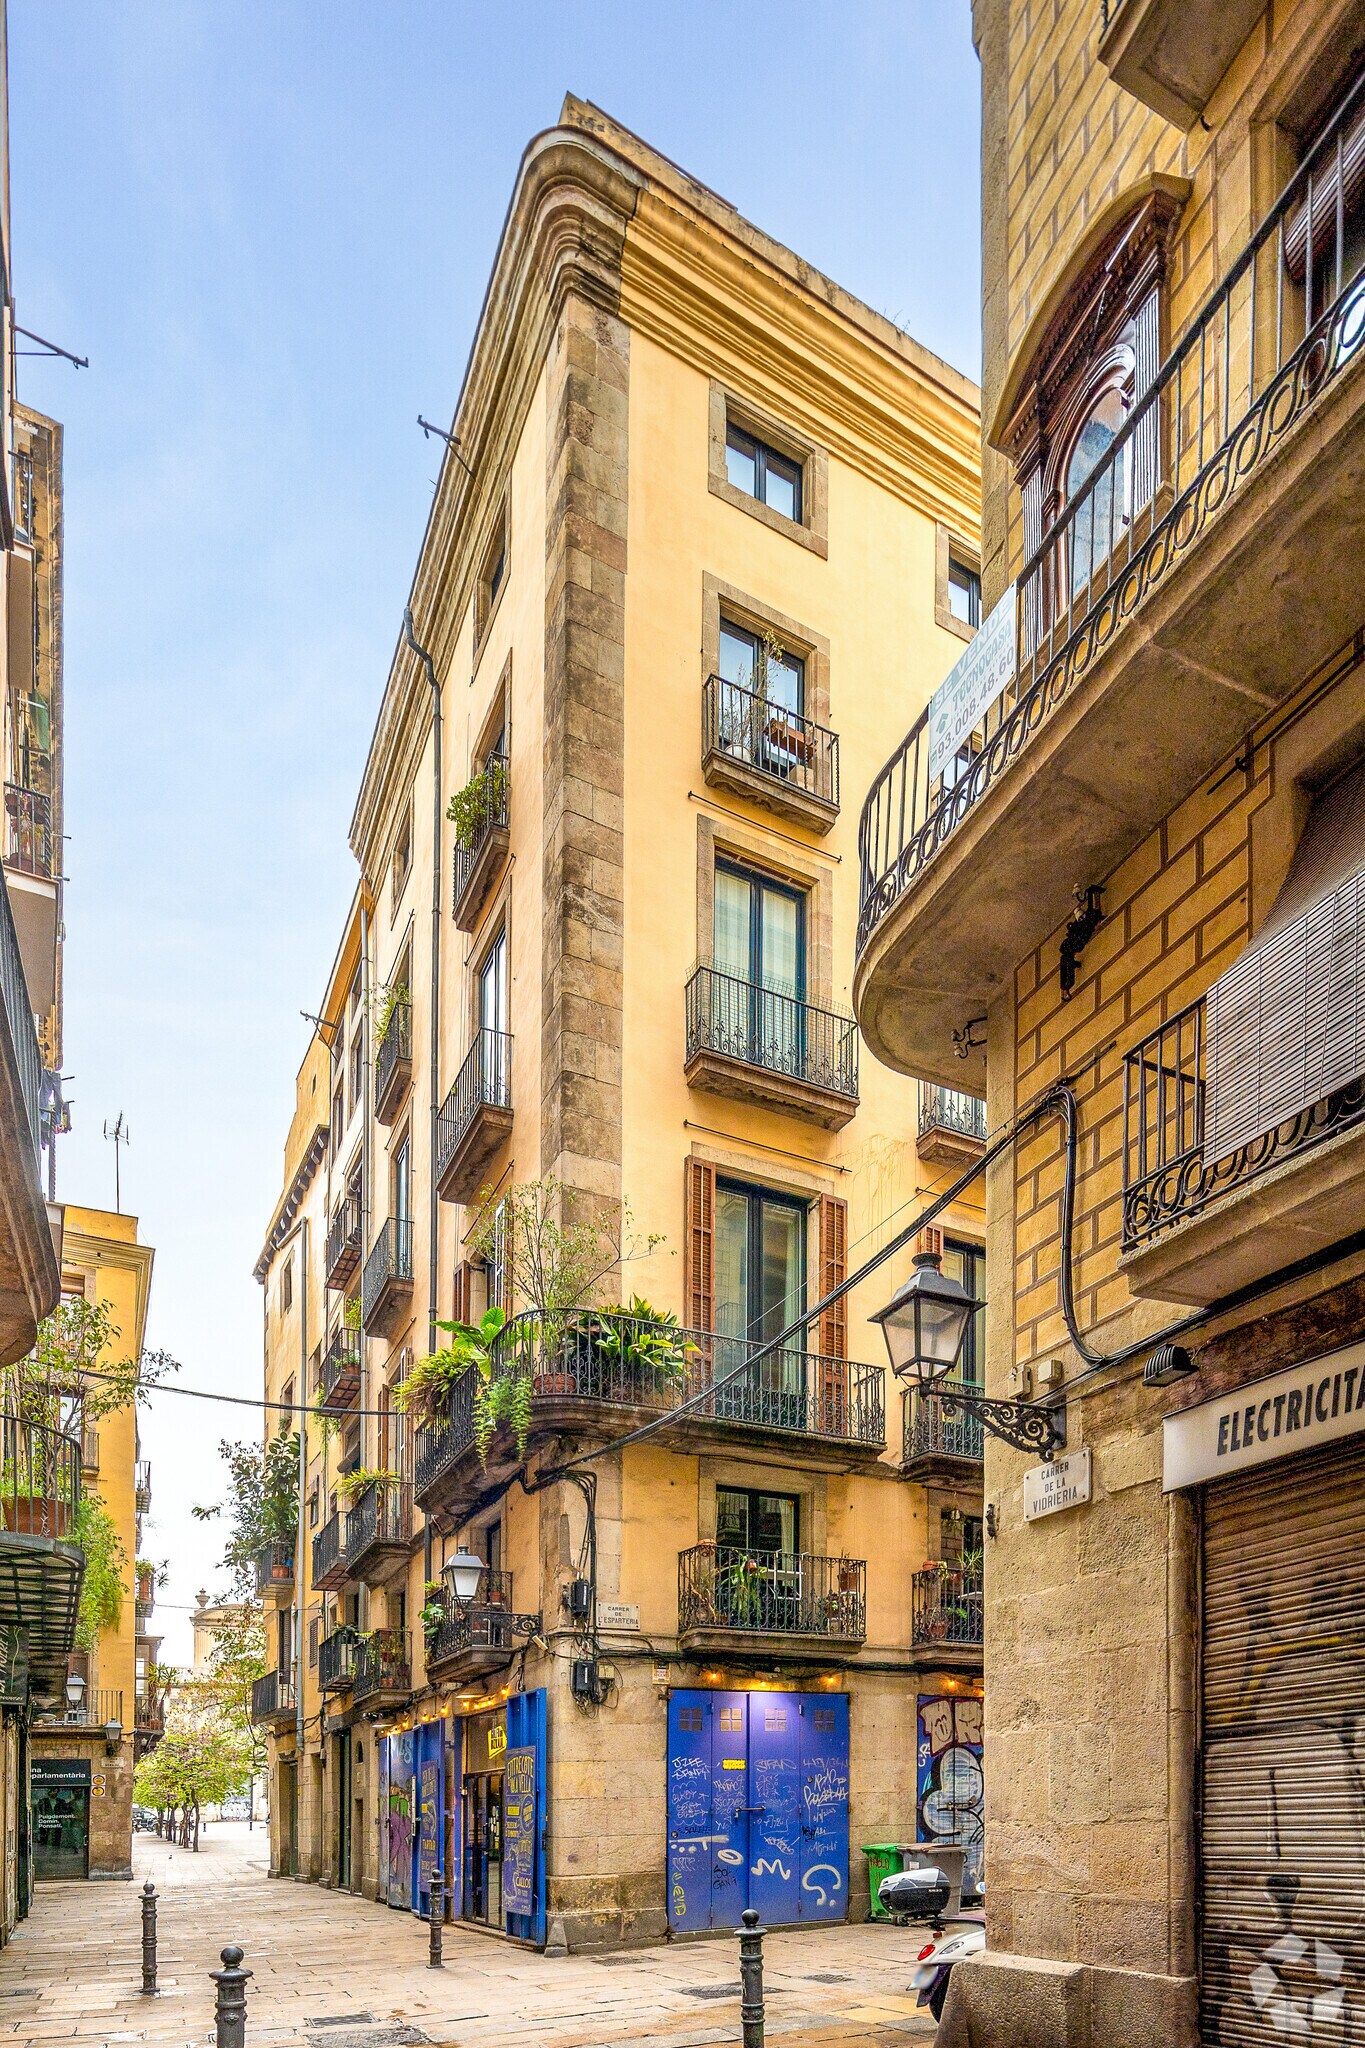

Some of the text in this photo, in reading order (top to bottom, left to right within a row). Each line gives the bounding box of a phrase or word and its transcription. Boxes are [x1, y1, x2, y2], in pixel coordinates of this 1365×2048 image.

[934, 672, 953, 713] SE
[956, 591, 1009, 681] VENDE
[952, 614, 1011, 715] TECNOCASA
[937, 642, 1013, 762] 93.008.48.60
[1041, 1461, 1069, 1480] CARRER
[1044, 1477, 1066, 1493] DE LA
[1033, 1486, 1078, 1513] VIDRIERIA
[598, 1616, 639, 1625] L'ESPARTERIA
[31, 1772, 86, 1780] parlamentària
